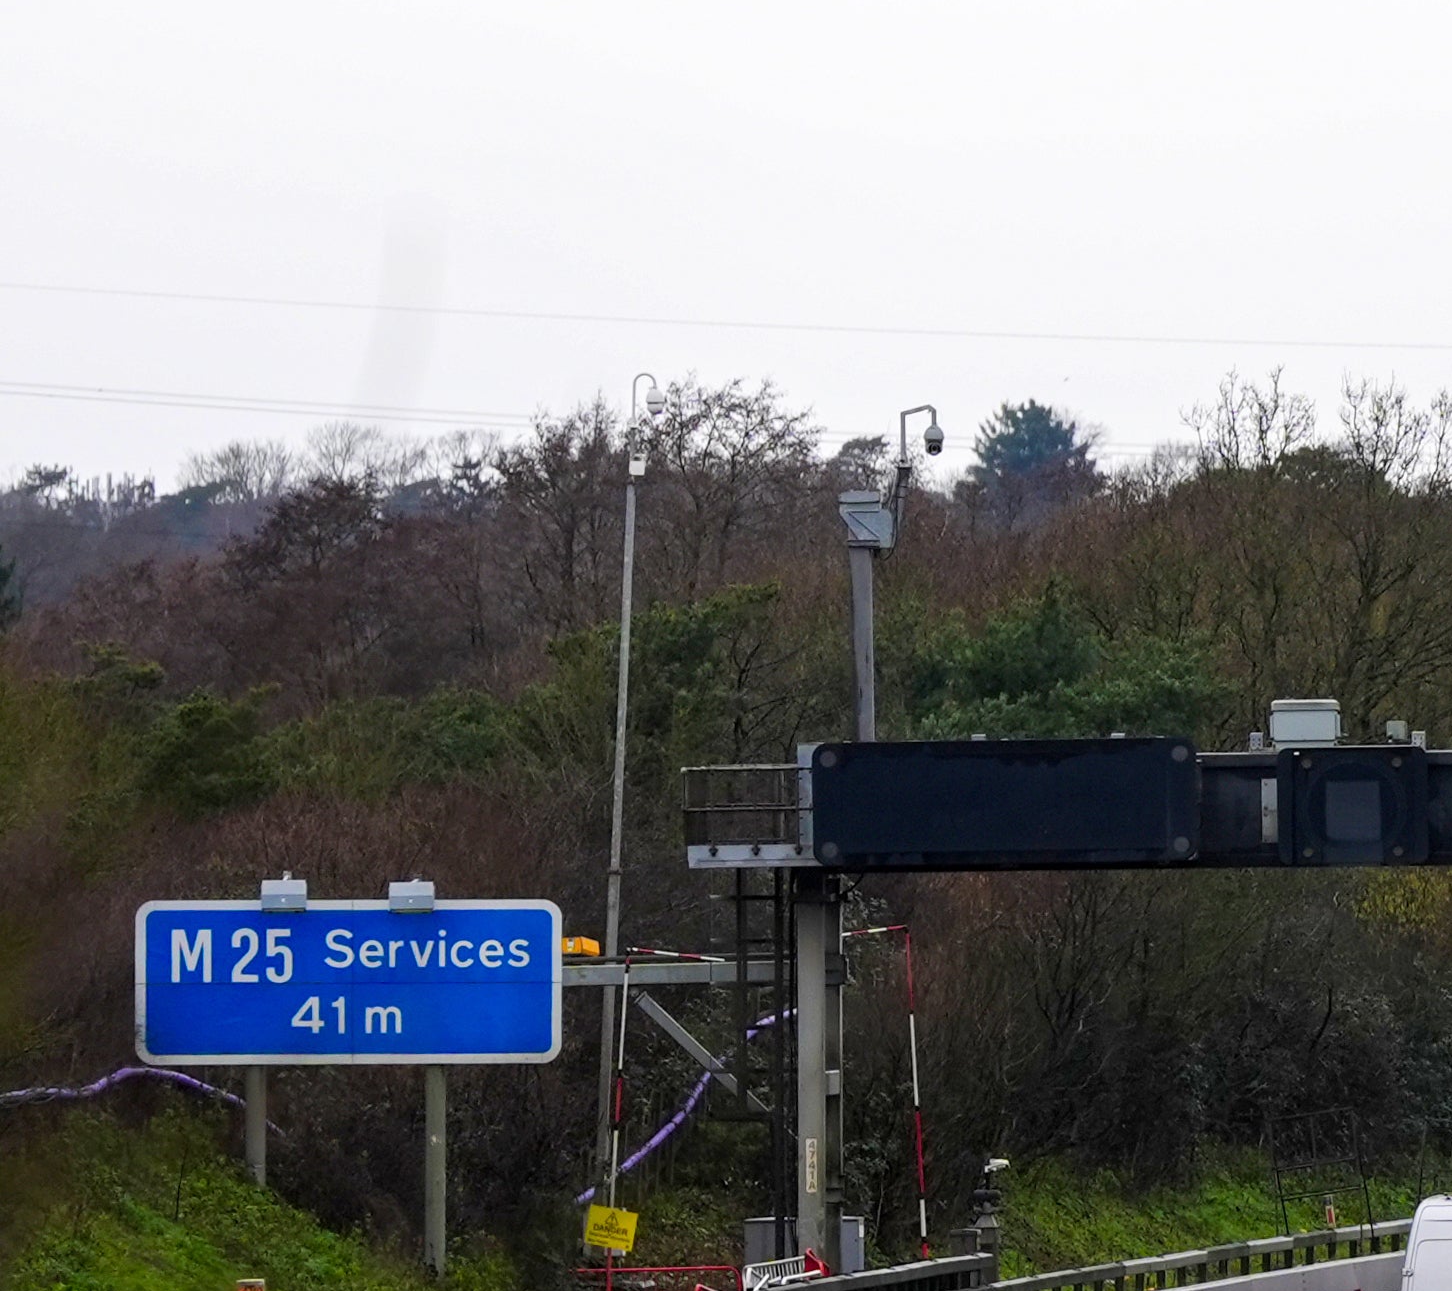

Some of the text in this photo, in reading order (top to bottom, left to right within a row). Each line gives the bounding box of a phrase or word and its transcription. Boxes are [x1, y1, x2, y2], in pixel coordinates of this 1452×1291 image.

[170, 927, 531, 984] M 25 Services
[291, 995, 403, 1035] 41 m
[592, 1221, 630, 1238] DANGER
